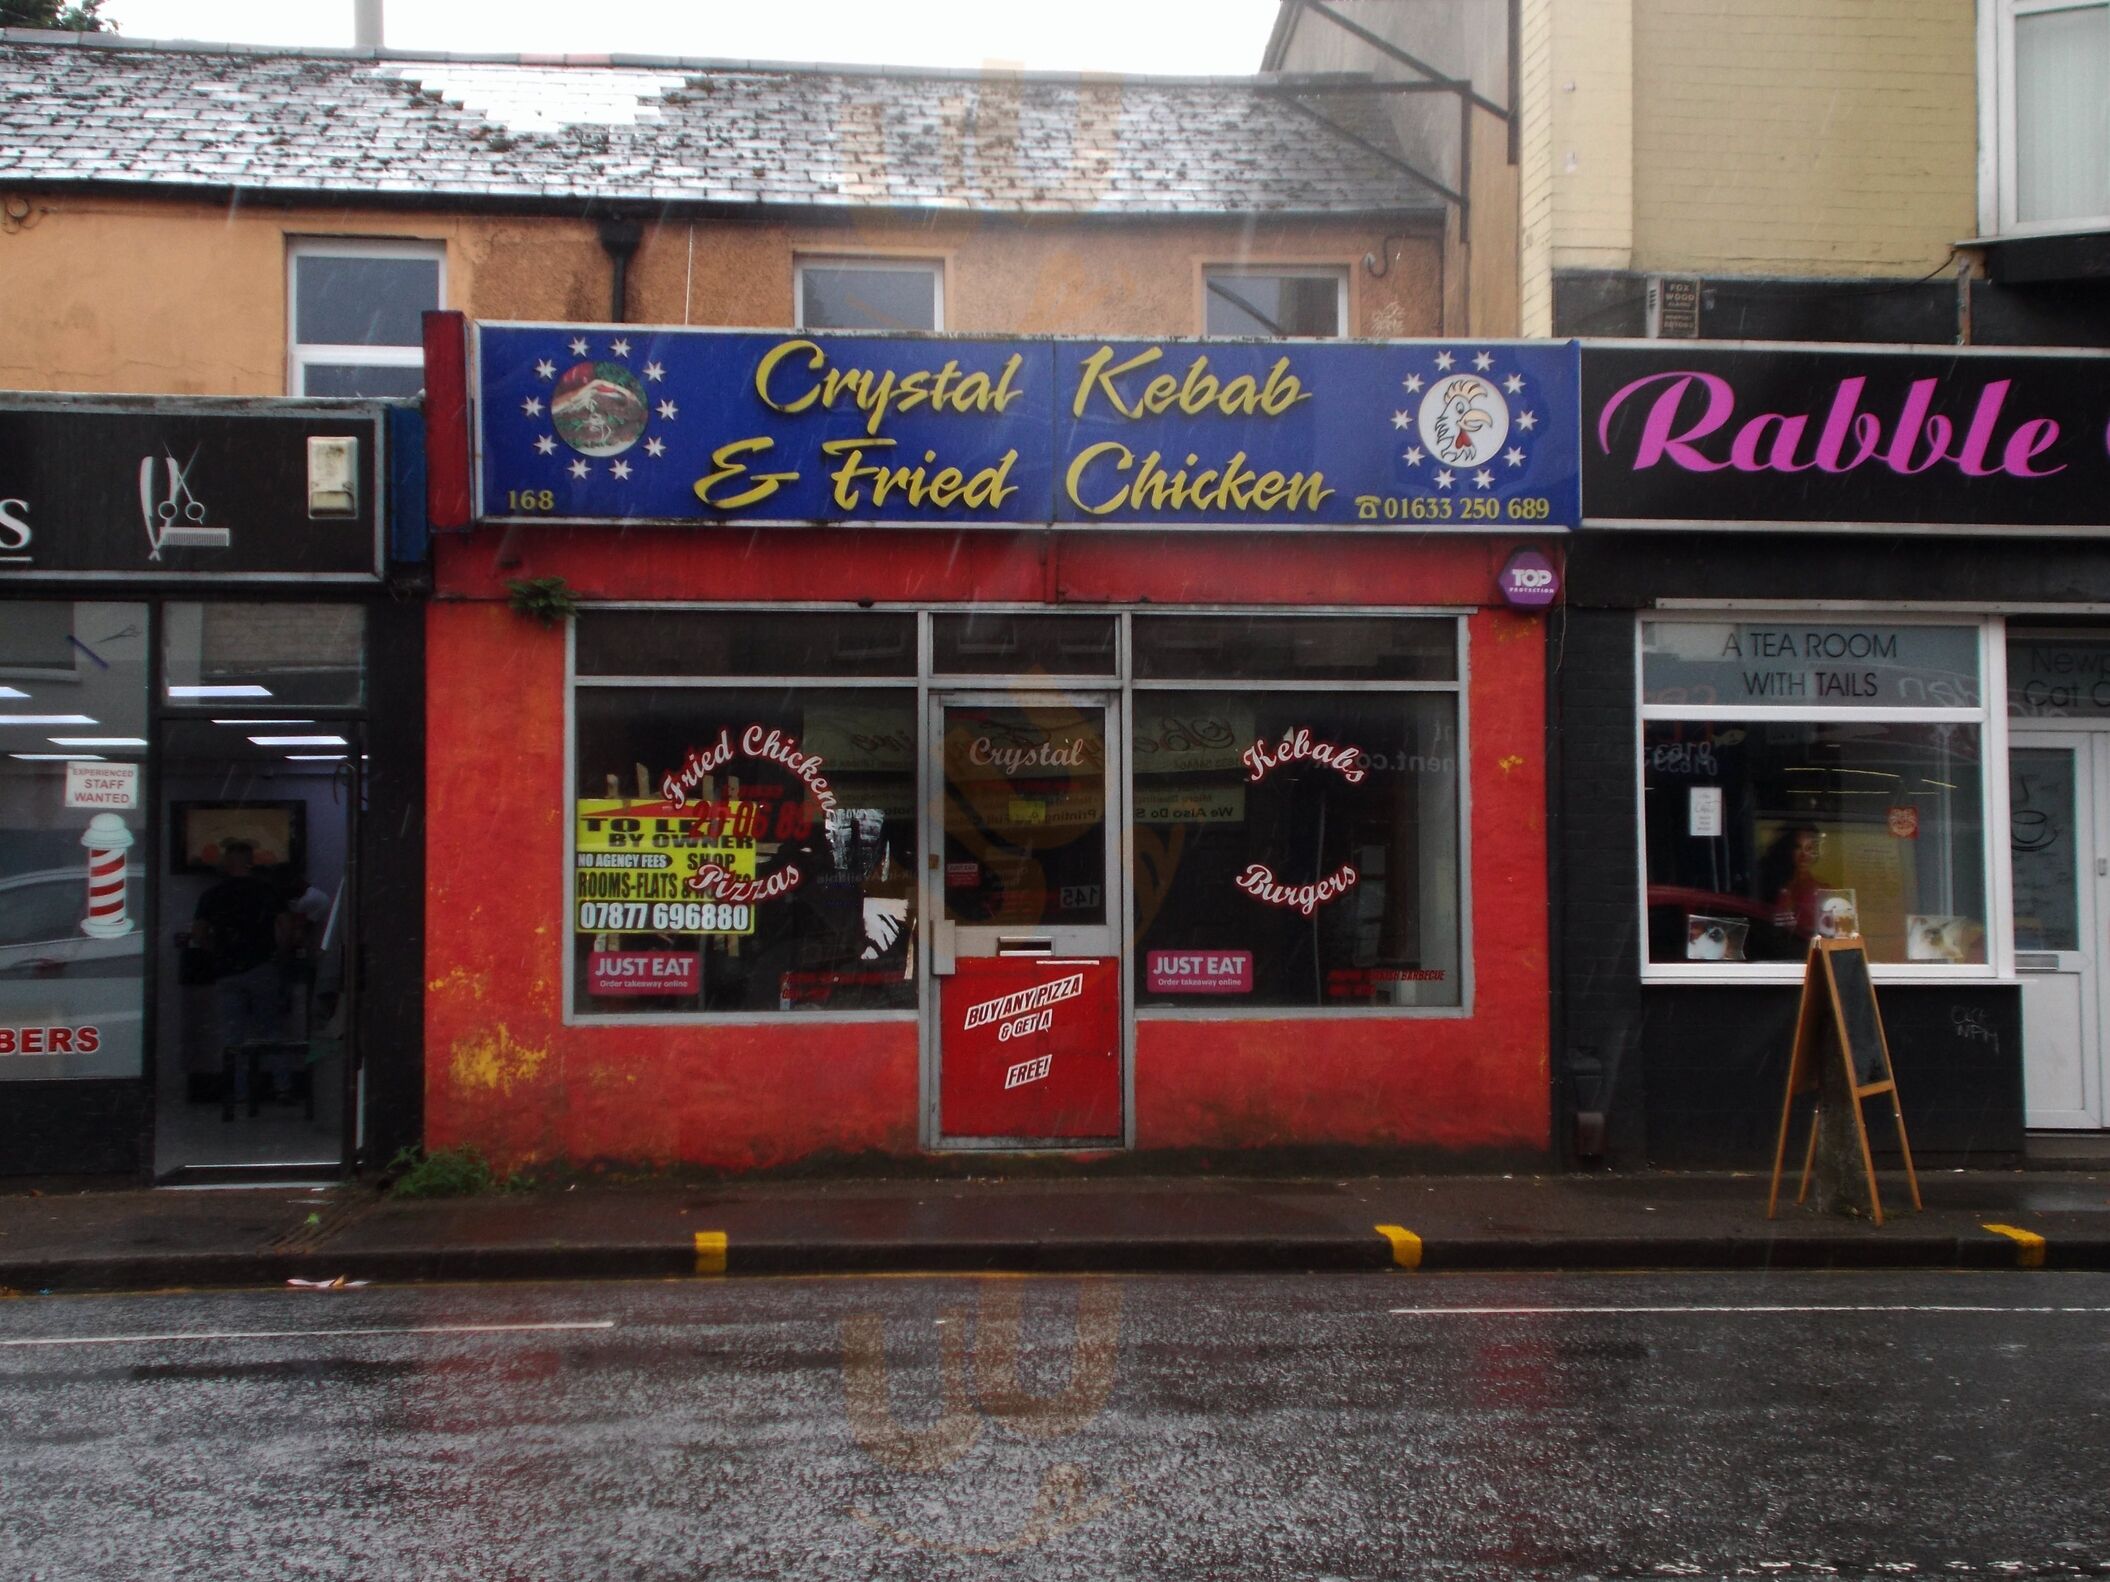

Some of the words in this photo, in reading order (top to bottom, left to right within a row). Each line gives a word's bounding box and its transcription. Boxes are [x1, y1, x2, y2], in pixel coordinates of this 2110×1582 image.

[755, 340, 1023, 434] Crystal
[1072, 344, 1312, 419] Kebab
[1598, 371, 2068, 477] Rabble
[693, 436, 800, 510] &
[822, 438, 1018, 510] Fried
[1065, 441, 1335, 514] Chicken
[506, 490, 555, 510] 168
[1385, 496, 1453, 520] 01633
[1460, 496, 1500, 520] 250
[1508, 496, 1550, 520] 689
[1512, 568, 1553, 587] TOP
[1722, 633, 1743, 657] A
[1750, 633, 1797, 657] TEA
[1806, 633, 1897, 659] ROOM
[1743, 672, 1805, 697] WITH
[1816, 672, 1878, 697] TAILS
[2023, 679, 2081, 707] Cat
[968, 736, 1085, 775] Crystal
[1243, 729, 1366, 783] Kebabs
[72, 767, 134, 778] EXPERIENCED
[84, 778, 125, 790] STAFF
[662, 730, 734, 810] Fried
[742, 725, 841, 822] Chicken
[74, 791, 129, 804] WANTED
[580, 817, 641, 833] TO
[608, 833, 645, 848] BY
[652, 834, 754, 849] OWNER
[577, 854, 592, 868] NO
[595, 854, 640, 868] AGENCY
[641, 855, 668, 868] FEES
[687, 853, 736, 871] SHOP
[577, 872, 678, 899] ROOMS-FLATS
[688, 864, 801, 901] Pizzas
[1235, 864, 1357, 915] Burgers
[580, 902, 648, 930] 07877
[652, 903, 749, 930] 696880
[595, 957, 649, 976] JUST
[652, 958, 694, 976] EAT
[1153, 956, 1204, 975] JUST
[1207, 957, 1246, 975] EAT
[600, 979, 622, 988] Order
[624, 979, 662, 990] takeaway
[664, 980, 688, 988] online
[1158, 978, 1179, 986] Order
[1181, 978, 1218, 987] takeaway
[965, 1000, 1002, 1029] BUY
[1000, 987, 1035, 1018] ANY
[1035, 975, 1082, 1008] PIZZA
[0, 1026, 100, 1055] BERS
[999, 1023, 1012, 1041] &
[1013, 1015, 1038, 1036] GET
[1005, 1056, 1051, 1088] FREE!
